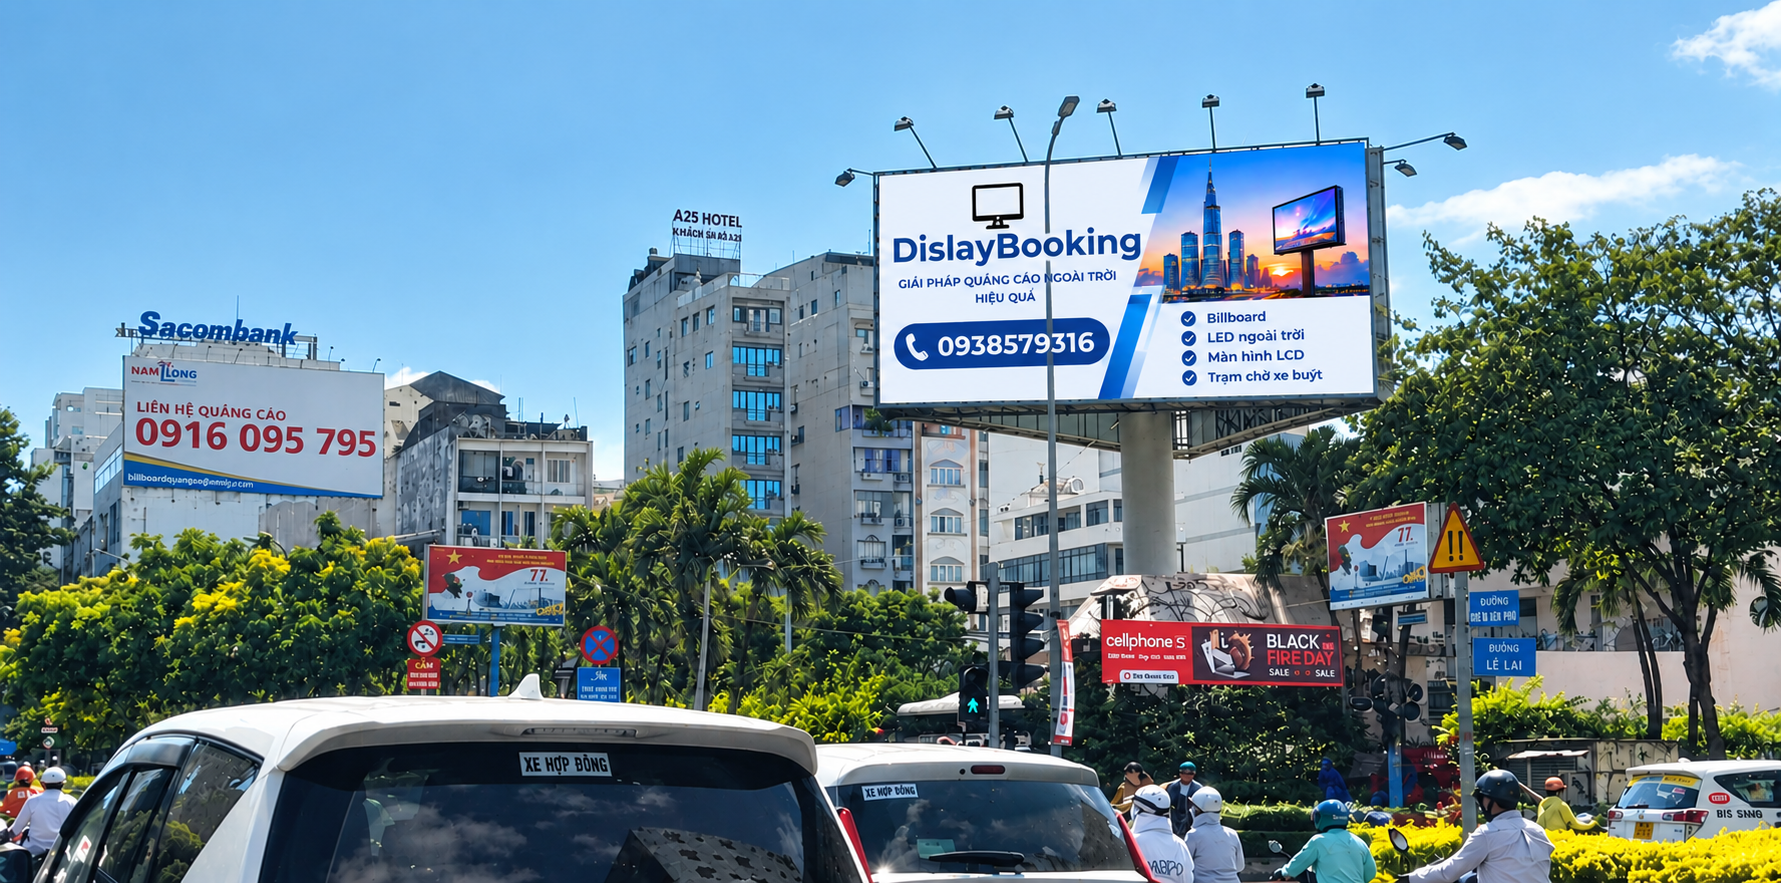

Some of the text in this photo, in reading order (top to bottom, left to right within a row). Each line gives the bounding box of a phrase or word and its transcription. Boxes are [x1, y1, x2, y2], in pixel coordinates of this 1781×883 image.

[673, 209, 742, 228] A25 HOTEL
[893, 227, 1141, 266] DislayBooking
[926, 274, 961, 288] PHÁP
[1013, 271, 1041, 285] CÁO
[1044, 269, 1084, 284] NGOÀI
[1087, 268, 1117, 282] TRỜI
[975, 291, 1004, 306] HIỆU
[1207, 311, 1267, 324] Billboard
[138, 311, 298, 346] Sacombank
[1207, 328, 1305, 344] LED ngoài trời
[937, 331, 1095, 357] 0938579316
[1208, 350, 1305, 363] Màn hình LCD
[131, 366, 159, 376] NAM
[1208, 368, 1323, 385] Trạm chờ xe buýt
[136, 400, 170, 414] LIÊN
[175, 402, 194, 418] HỆ
[135, 417, 377, 457] 0916 095 795
[1106, 633, 1173, 651] cellphone
[1266, 633, 1320, 650] BLACK
[1267, 649, 1334, 666] FIRE DAY
[1504, 660, 1522, 671] LAI
[1268, 667, 1335, 678] SALE SALE
[523, 757, 542, 772] XE
[864, 788, 876, 798] XE
[1717, 809, 1733, 819] BIS
